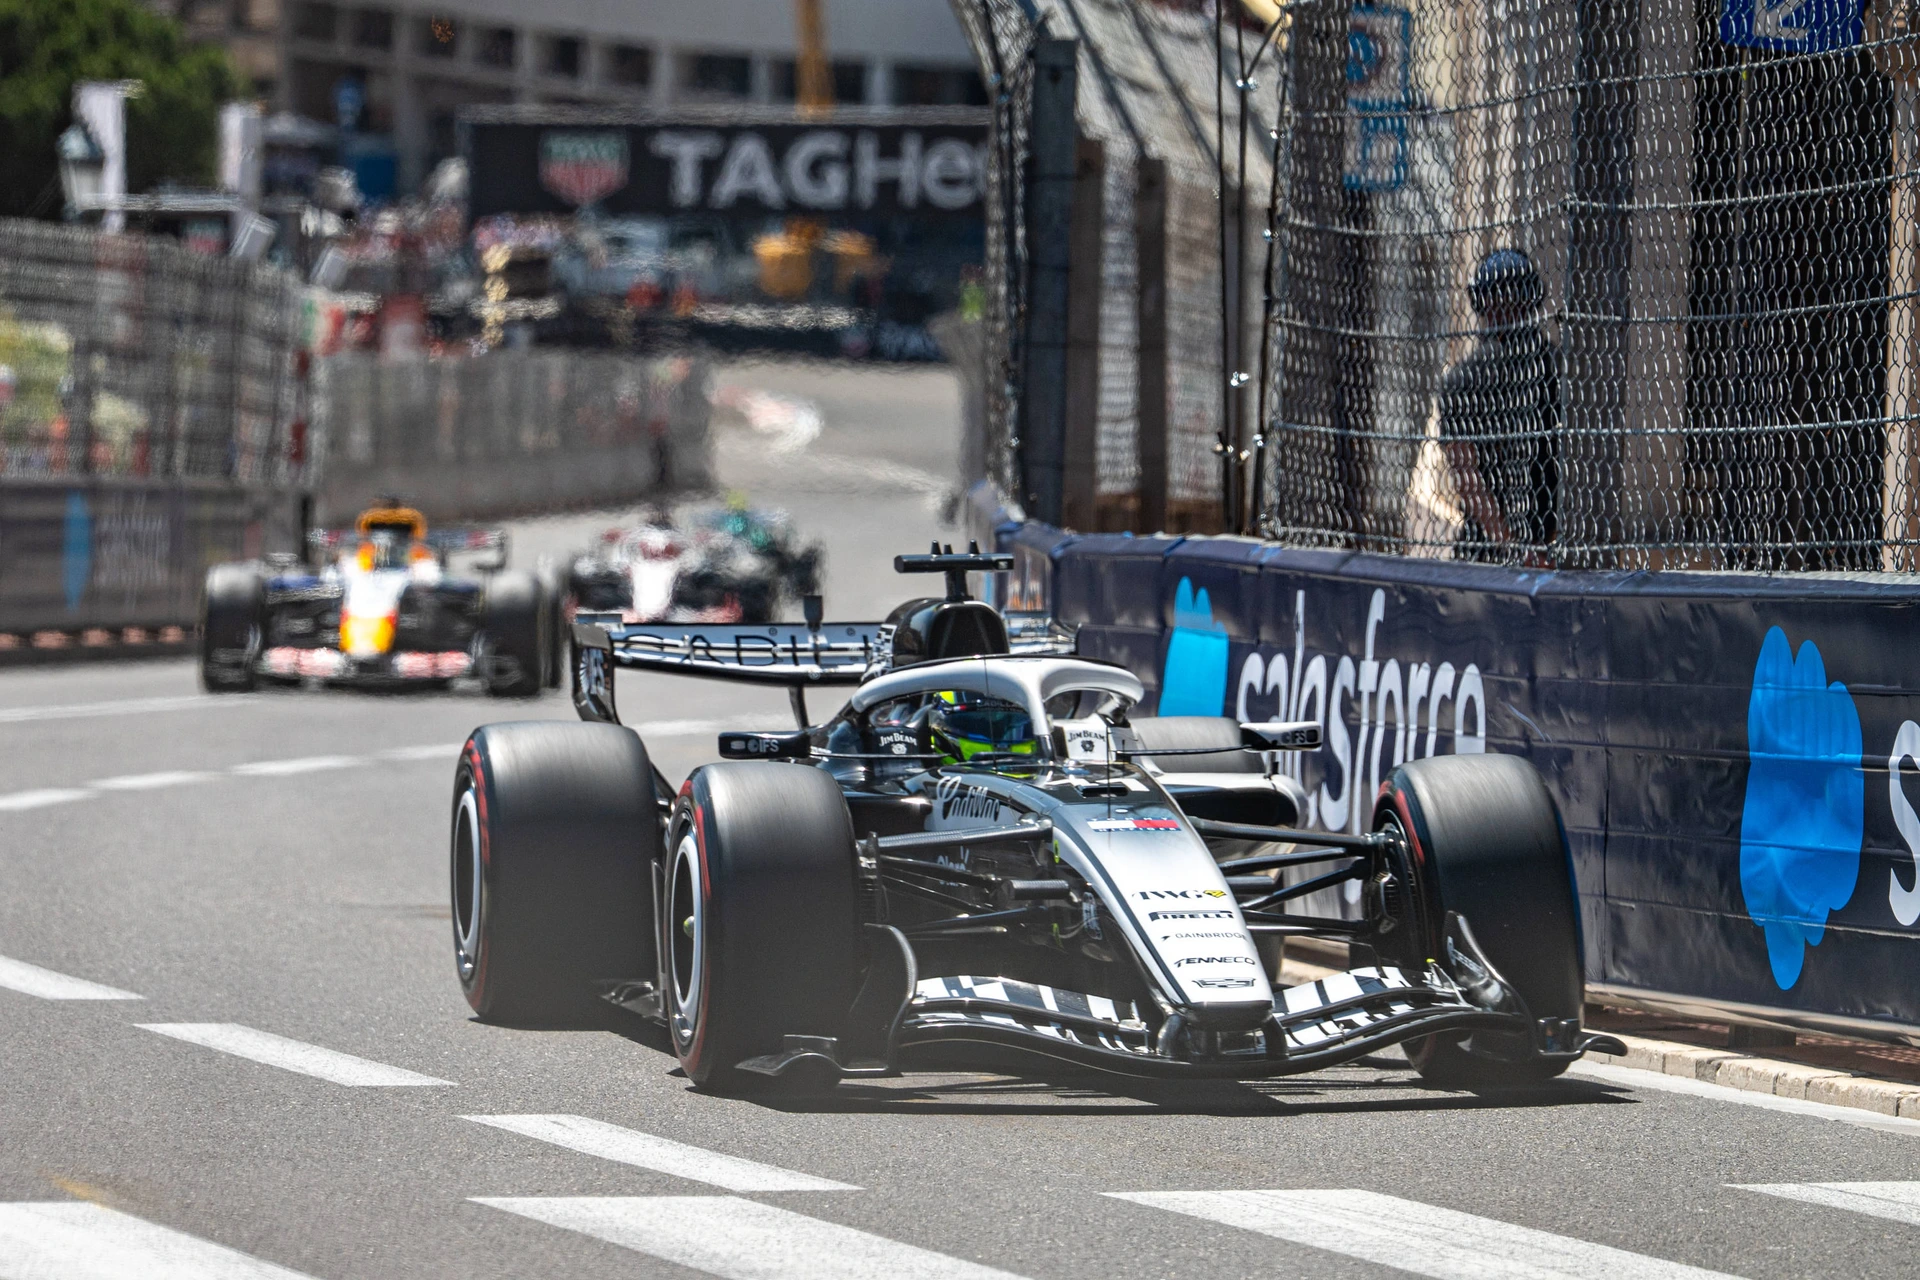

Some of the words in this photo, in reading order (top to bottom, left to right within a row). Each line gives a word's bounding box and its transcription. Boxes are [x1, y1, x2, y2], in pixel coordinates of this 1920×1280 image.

[879, 735, 893, 746] JIM
[893, 732, 918, 746] BEAM
[1068, 731, 1083, 742] JIM
[1083, 730, 1106, 742] BEAM
[936, 775, 1000, 822] Cadillac
[1148, 910, 1234, 922] PIRELLI
[1174, 956, 1256, 968] TENNECO
